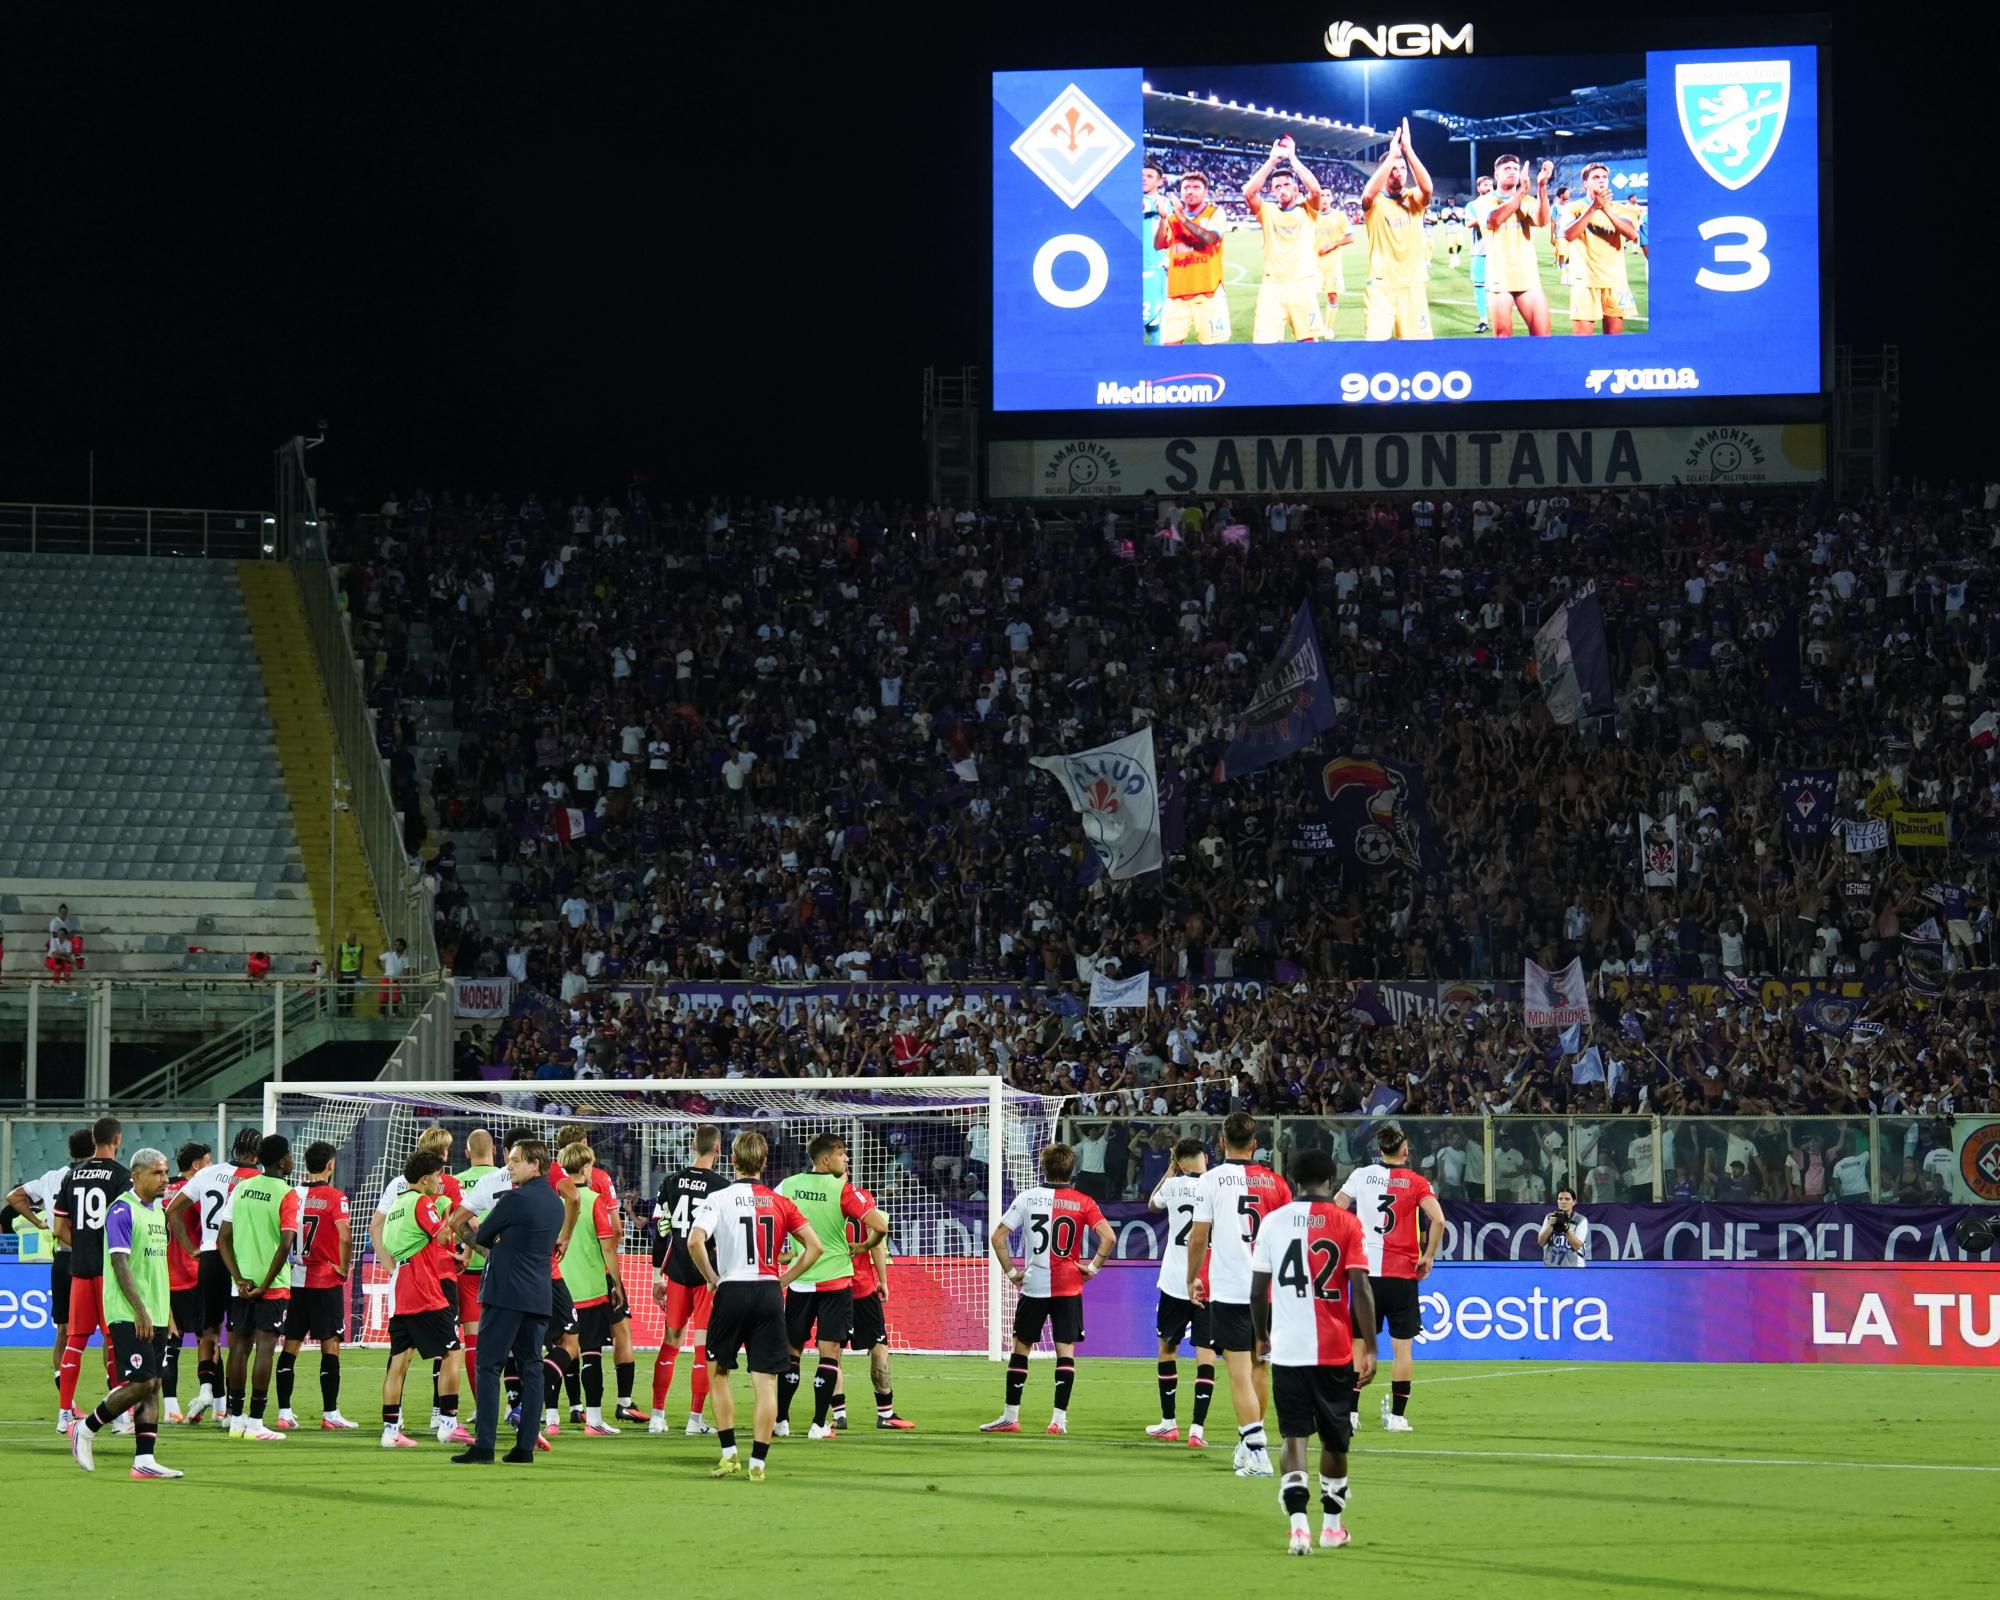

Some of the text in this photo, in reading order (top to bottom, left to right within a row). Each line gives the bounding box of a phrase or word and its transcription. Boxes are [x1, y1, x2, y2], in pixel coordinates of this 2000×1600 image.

[1346, 21, 1474, 58] NGM
[1032, 233, 1110, 308] 0
[1695, 215, 1771, 292] 3
[1096, 380, 1214, 404] Mediacom
[1340, 370, 1472, 402] 90:00
[1045, 441, 1121, 479] SAMMONTANA
[1164, 429, 1643, 492] SAMMONTANA
[1686, 428, 1765, 466] SAMMONTANA
[1850, 832, 1887, 850] VIVE
[460, 985, 503, 1009] MODENA
[1528, 1008, 1588, 1026] MONTAIONE
[73, 1169, 113, 1181] LEZZERINI
[73, 1187, 107, 1230] 19
[1238, 1195, 1262, 1243] 5
[1293, 1214, 1326, 1228] INAO
[1373, 1193, 1397, 1235] 3
[739, 1216, 774, 1266] 11
[1030, 1213, 1077, 1258] 30
[1278, 1237, 1341, 1302] 42
[1455, 1286, 1614, 1342] estra
[1812, 1292, 2000, 1348] LA TU
